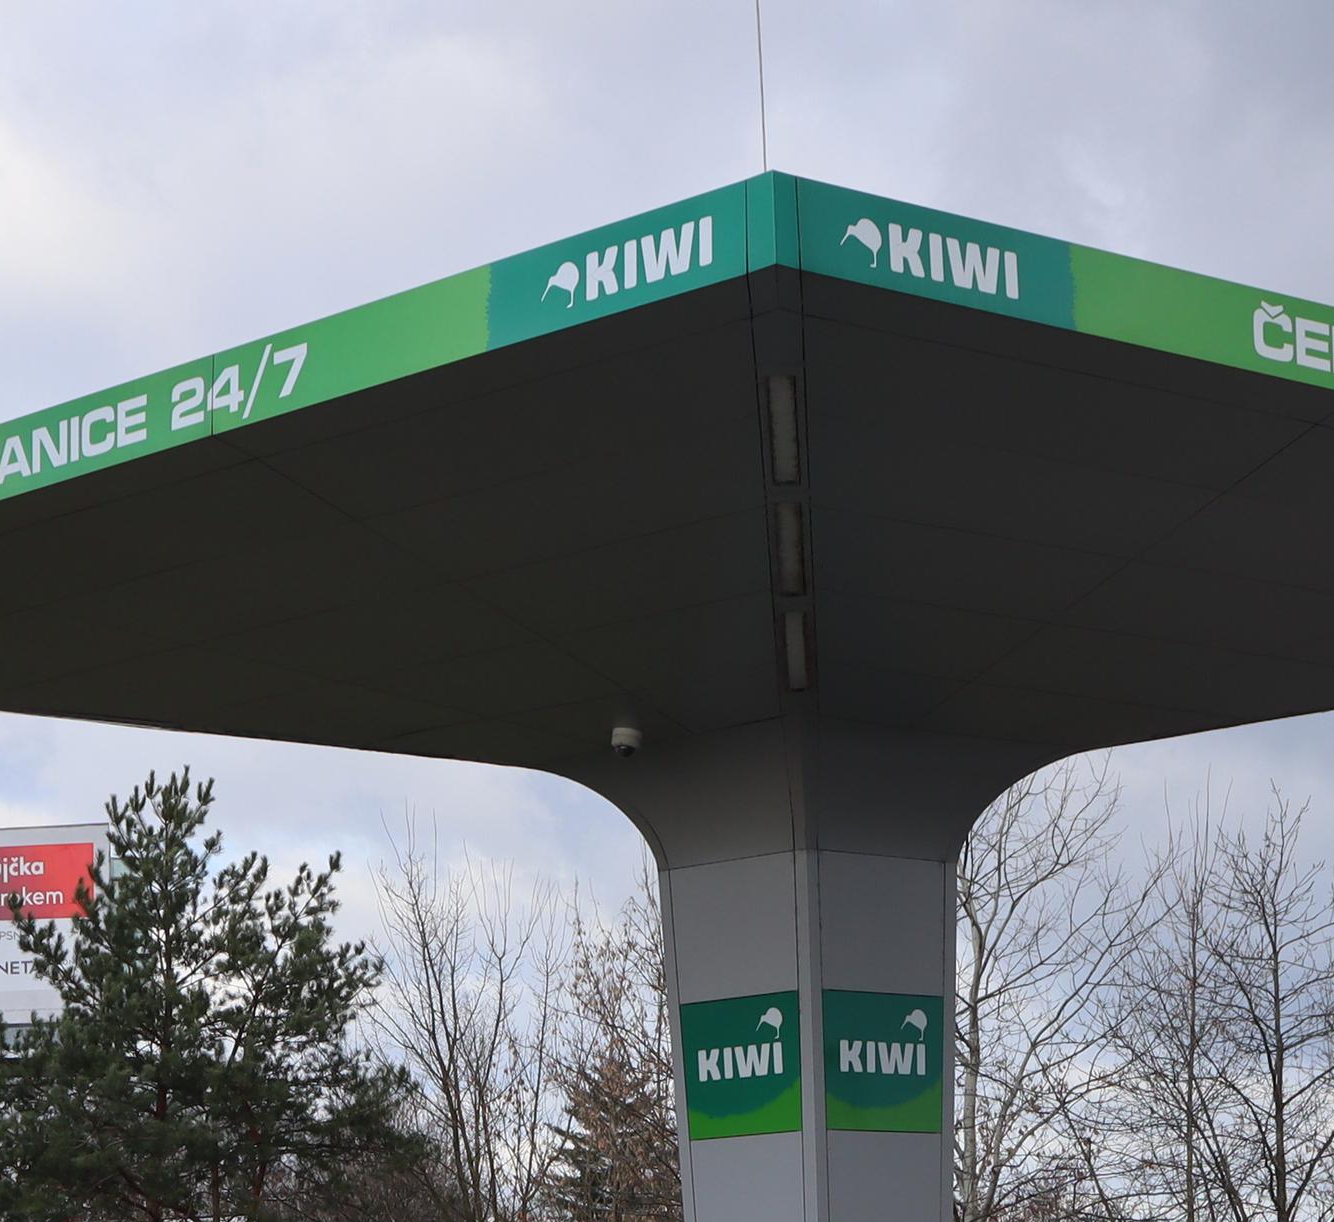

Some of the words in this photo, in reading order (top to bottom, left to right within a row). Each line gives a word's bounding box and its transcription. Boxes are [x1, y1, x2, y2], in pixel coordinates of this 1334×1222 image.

[585, 215, 713, 301] KIWI
[888, 223, 1020, 300] KIWI
[170, 342, 308, 431] 24/7
[698, 1042, 784, 1082] KIWI
[839, 1039, 927, 1076] KIWI
